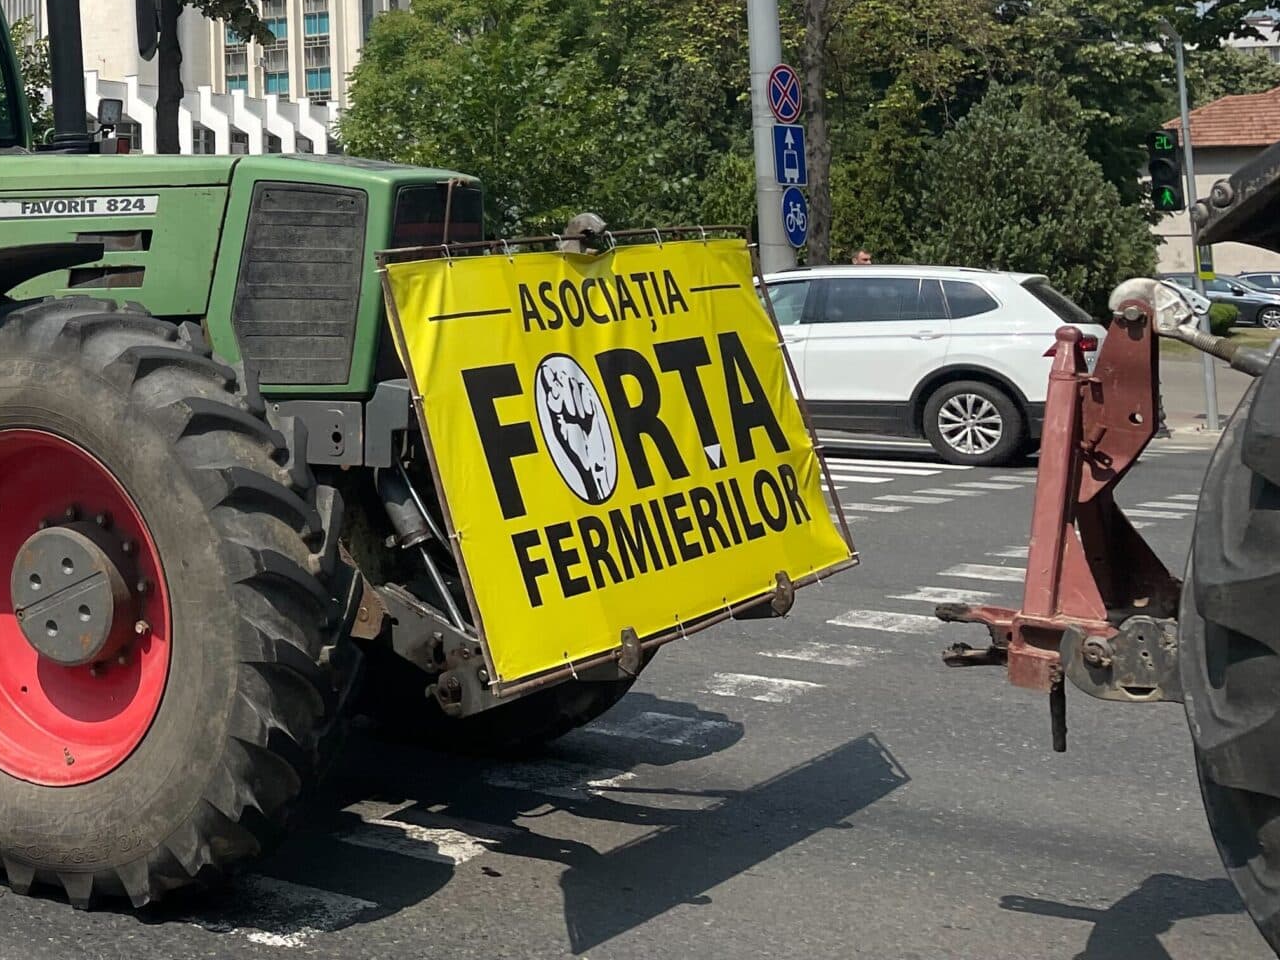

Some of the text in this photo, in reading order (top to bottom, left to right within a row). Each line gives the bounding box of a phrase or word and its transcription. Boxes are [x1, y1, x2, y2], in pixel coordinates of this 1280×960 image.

[20, 198, 146, 215] FAVORIT 824
[518, 269, 689, 333] ASOCIAȚIA
[510, 464, 811, 608] FERMIERILOR
